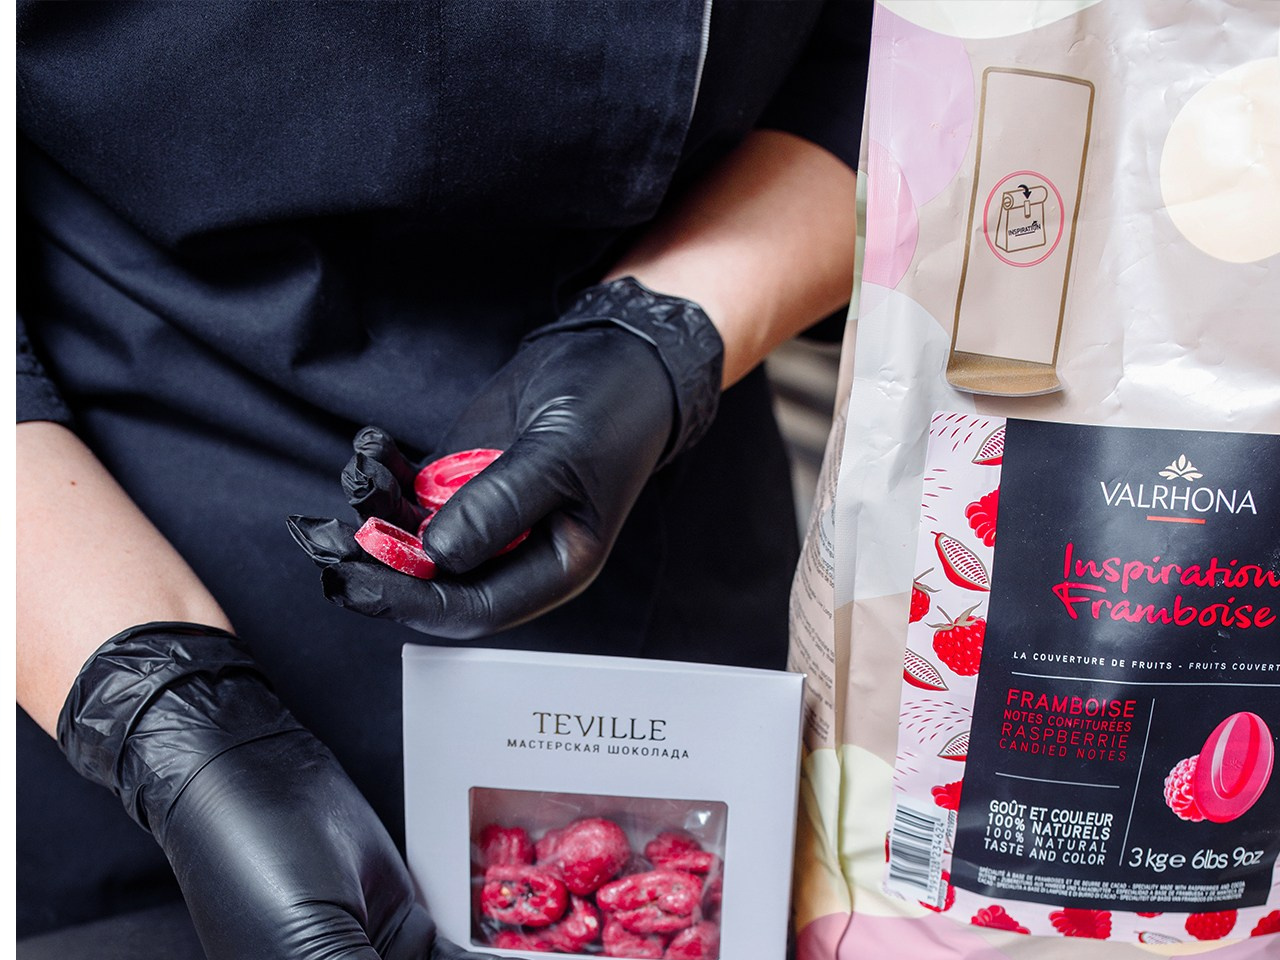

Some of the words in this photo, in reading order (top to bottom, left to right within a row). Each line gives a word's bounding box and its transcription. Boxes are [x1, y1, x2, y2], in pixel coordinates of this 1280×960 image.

[1100, 481, 1257, 515] VALRHONA
[1064, 542, 1280, 593] Inspiration
[1051, 581, 1277, 629] Framboise
[1013, 651, 1027, 660] LA
[1033, 653, 1105, 666] COUVERTURE
[1111, 659, 1126, 668] DE
[1131, 660, 1172, 670] FRUITS
[1188, 662, 1227, 671] FRUITS
[1006, 688, 1137, 718] FRAMBOISE
[532, 711, 667, 741] TEVILLE
[1003, 709, 1043, 724] NOTES
[1047, 715, 1132, 732] CONFITURÉES
[507, 739, 600, 753] МАСТЕРСКАЯ
[607, 744, 690, 760] ШОКОЛАДА
[1001, 722, 1129, 749] RASPBERRIE
[999, 738, 1067, 757] CANDIED
[1076, 748, 1127, 762] NOTES
[988, 812, 1025, 832] 100%
[1032, 821, 1111, 841] NATURELS
[989, 799, 1027, 817] GOÛT
[1029, 806, 1048, 820] ET
[1050, 808, 1114, 827] COULEUR
[933, 822, 945, 858] 234624
[984, 837, 1024, 856] TASTE
[1029, 847, 1056, 862] AND
[1062, 851, 1105, 866] COLOR
[986, 826, 1024, 843] 100%
[1034, 836, 1107, 853] NATURAL
[1128, 847, 1143, 868] 3
[1191, 849, 1228, 870] 6lbs
[1232, 846, 1265, 868] 9oz
